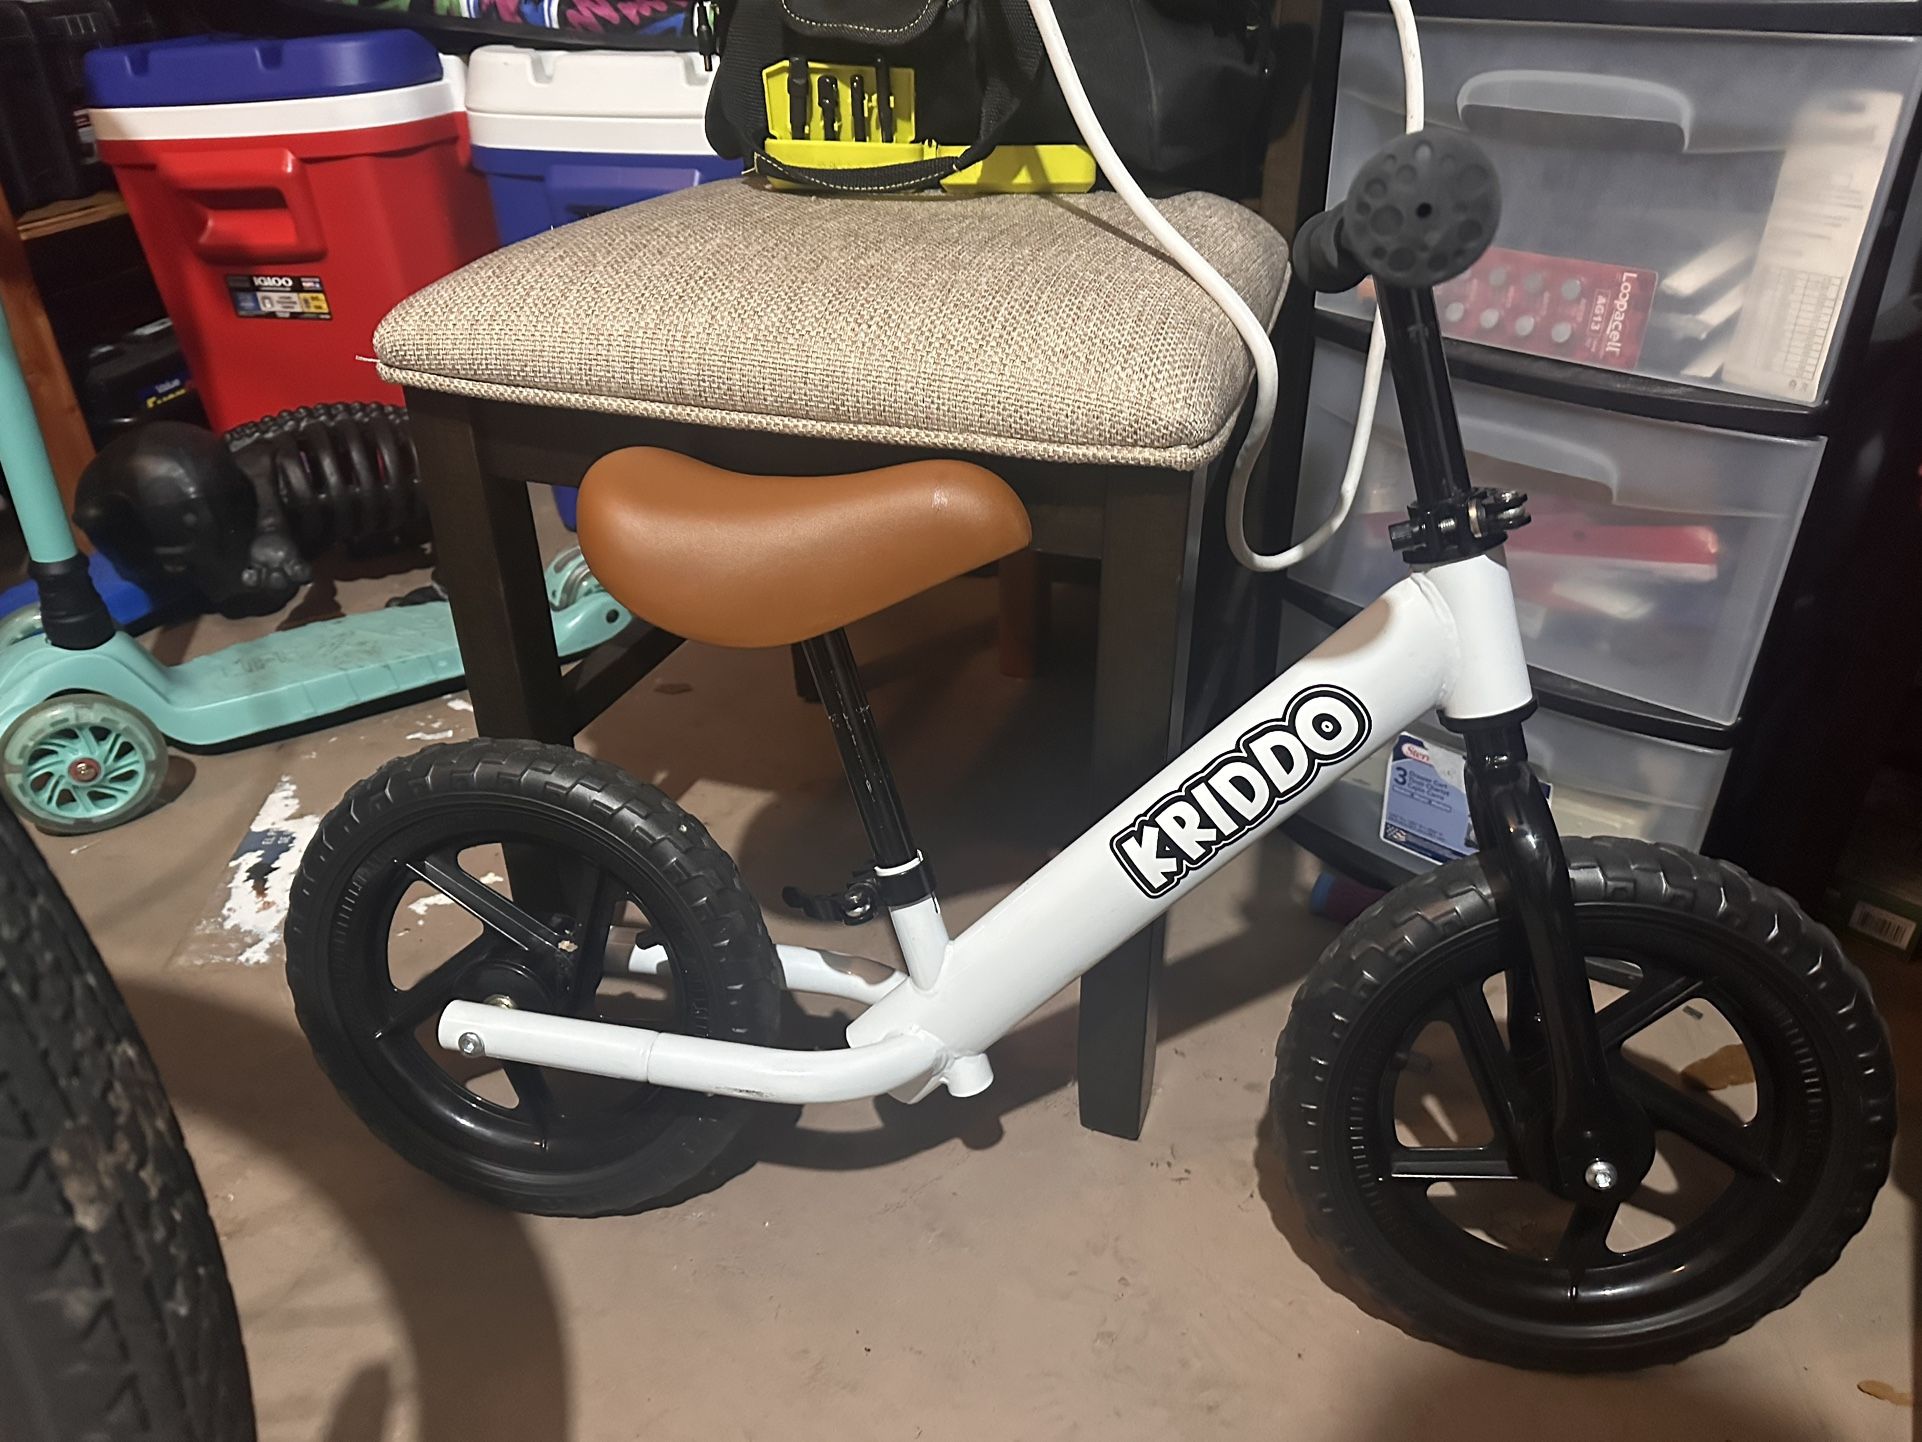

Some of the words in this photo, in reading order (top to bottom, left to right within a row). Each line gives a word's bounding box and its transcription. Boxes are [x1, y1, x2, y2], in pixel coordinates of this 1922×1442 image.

[253, 276, 293, 287] IGLOO
[1590, 294, 1606, 331] AG13
[1606, 271, 1637, 354] Loopacell
[1117, 691, 1364, 893] KRIDDO
[1393, 766, 1408, 786] 3
